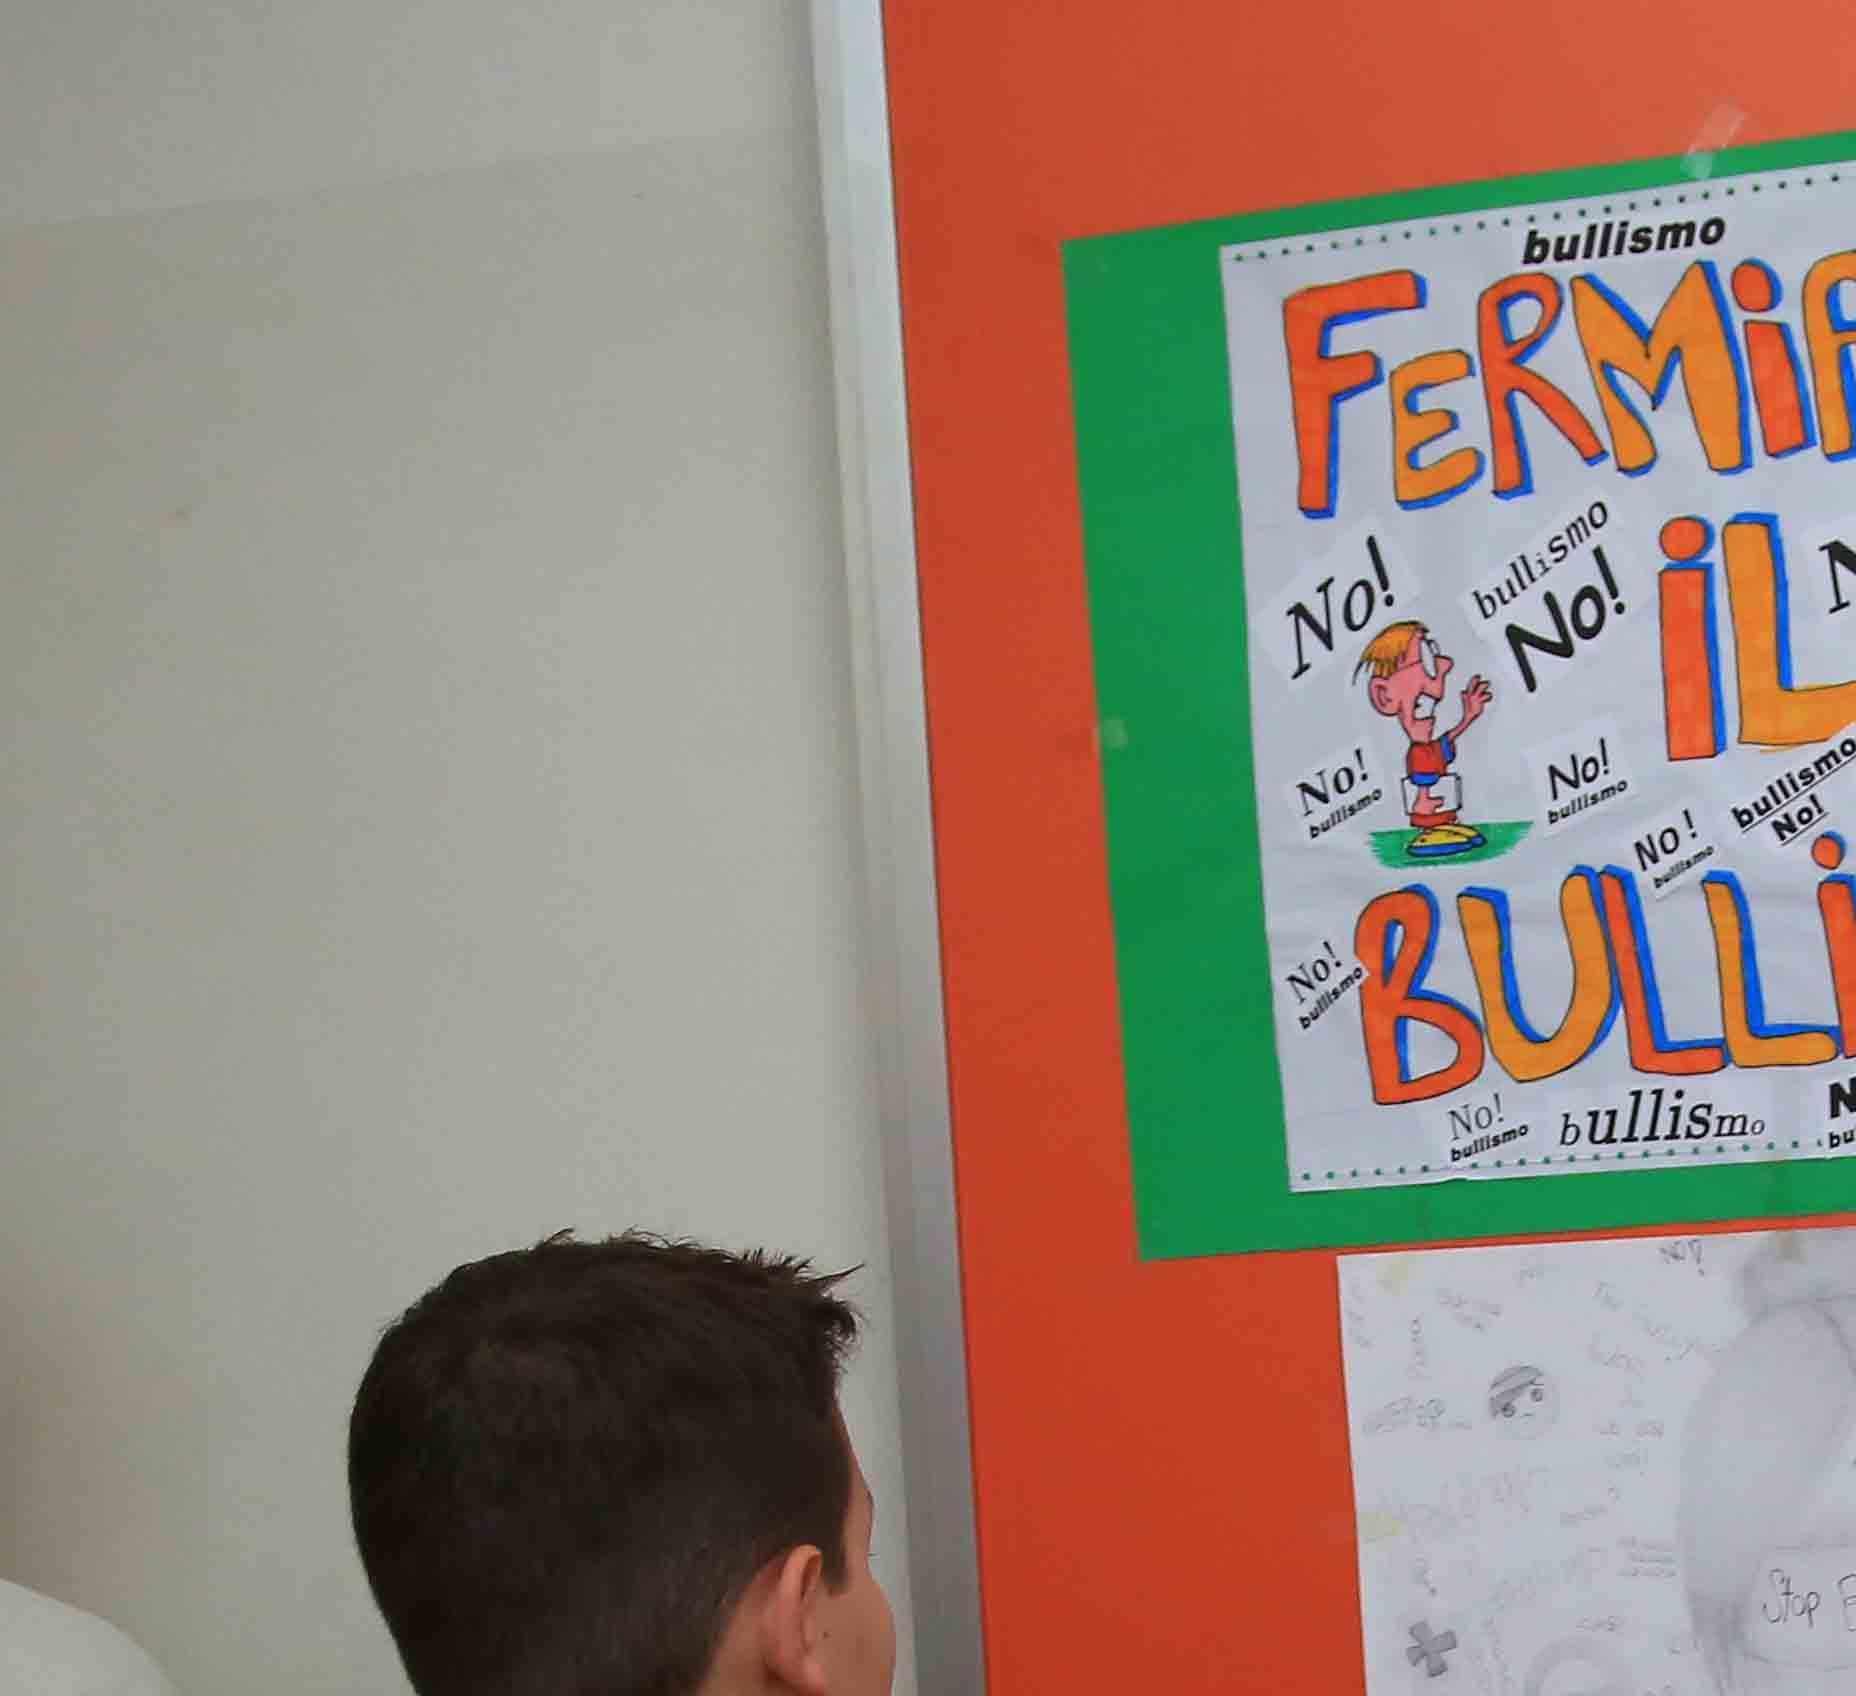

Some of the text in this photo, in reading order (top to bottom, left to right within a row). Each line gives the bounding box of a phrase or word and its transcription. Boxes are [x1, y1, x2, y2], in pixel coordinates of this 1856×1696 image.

[1522, 216, 1726, 265] bullismo
[1472, 499, 1609, 620] bullismo
[1284, 535, 1395, 680] No!
[1505, 544, 1626, 693] No!
[1296, 747, 1369, 818] No!
[1546, 736, 1610, 801] No!
[1731, 736, 1856, 829] bullismo
[1308, 787, 1383, 839] bullismo
[1546, 778, 1628, 825] bullismo
[1771, 794, 1824, 841] No!
[1652, 844, 1715, 889] bullismo
[1285, 940, 1343, 1005] No!
[1299, 966, 1364, 1030] bullismo
[1448, 1093, 1506, 1142] No!
[1450, 1122, 1529, 1164] bullismo
[1559, 1089, 1765, 1148] bullismo
[1762, 1568, 1821, 1630] Stop
